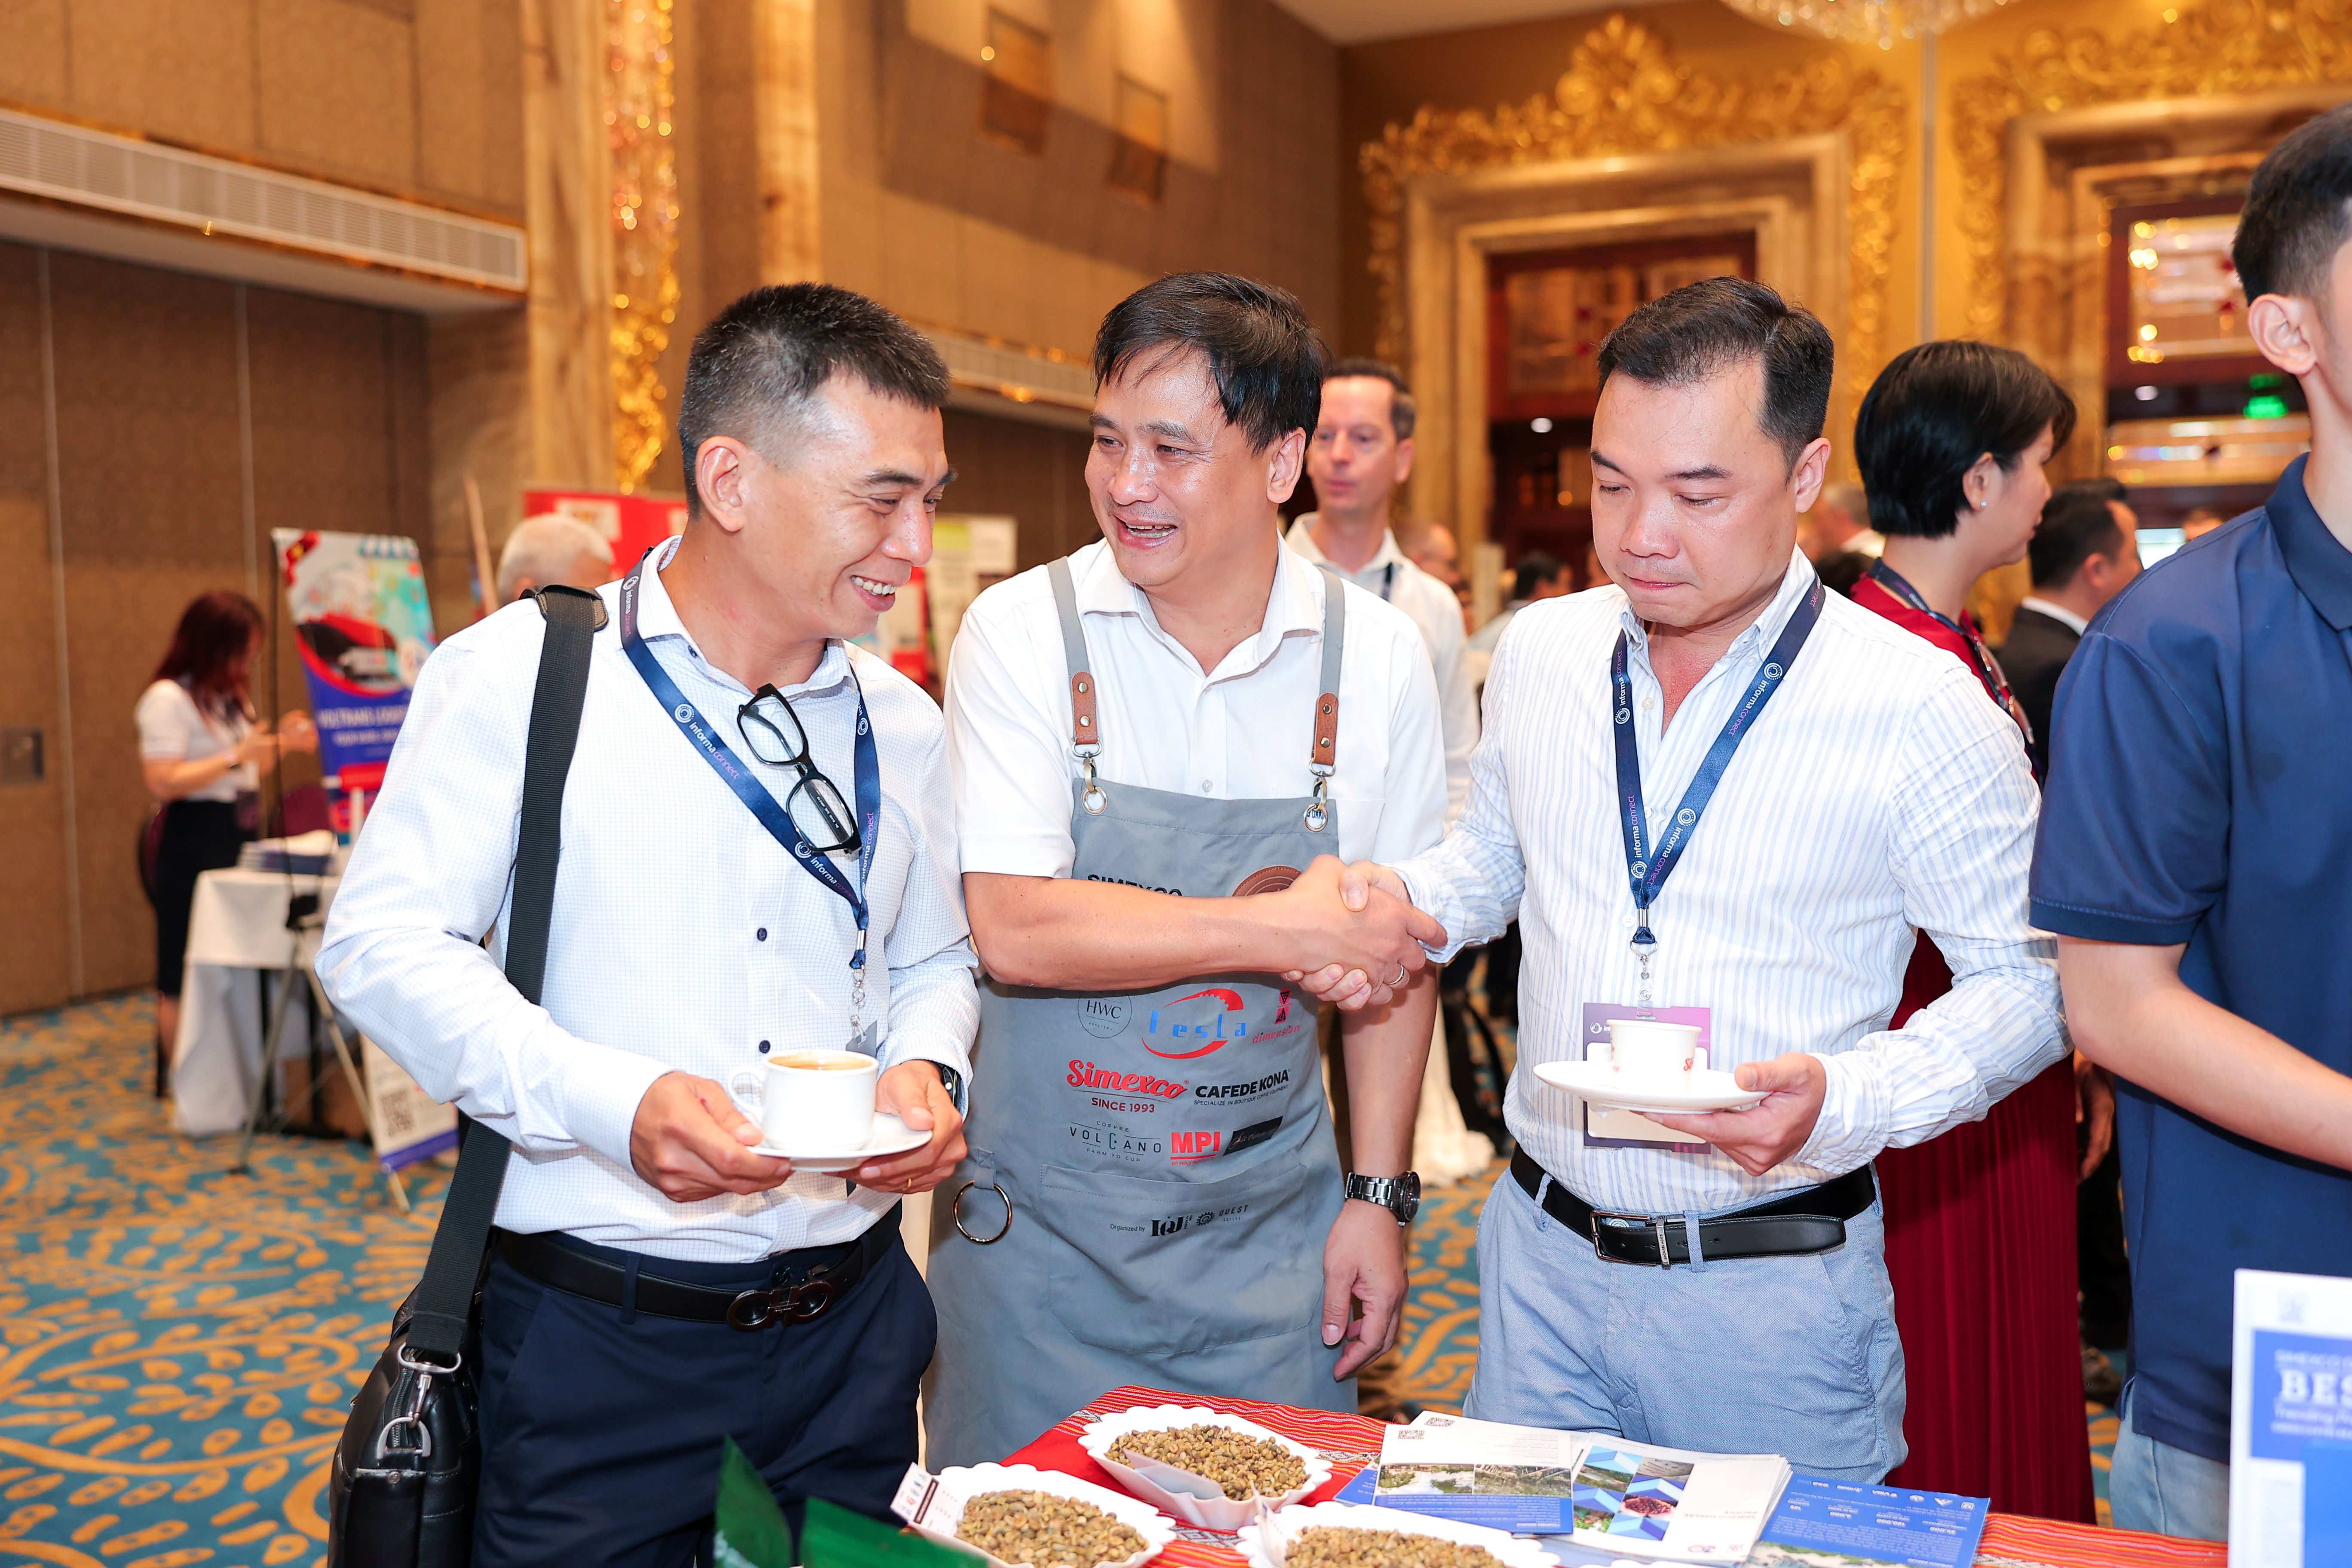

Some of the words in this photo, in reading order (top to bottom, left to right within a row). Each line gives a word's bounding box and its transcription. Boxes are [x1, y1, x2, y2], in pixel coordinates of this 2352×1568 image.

[1086, 999, 1122, 1019] HWC
[1148, 1009, 1246, 1038] Tesla
[1252, 1025, 1301, 1044] dimension
[1259, 1069, 1289, 1092] KONA
[1091, 1097, 1126, 1112] SINCE
[1129, 1103, 1155, 1113] 1993
[1096, 1121, 1130, 1133] COFFEE
[1086, 1148, 1107, 1156] FARM
[1171, 1131, 1221, 1154] MPI
[1110, 1224, 1138, 1232] Organized
